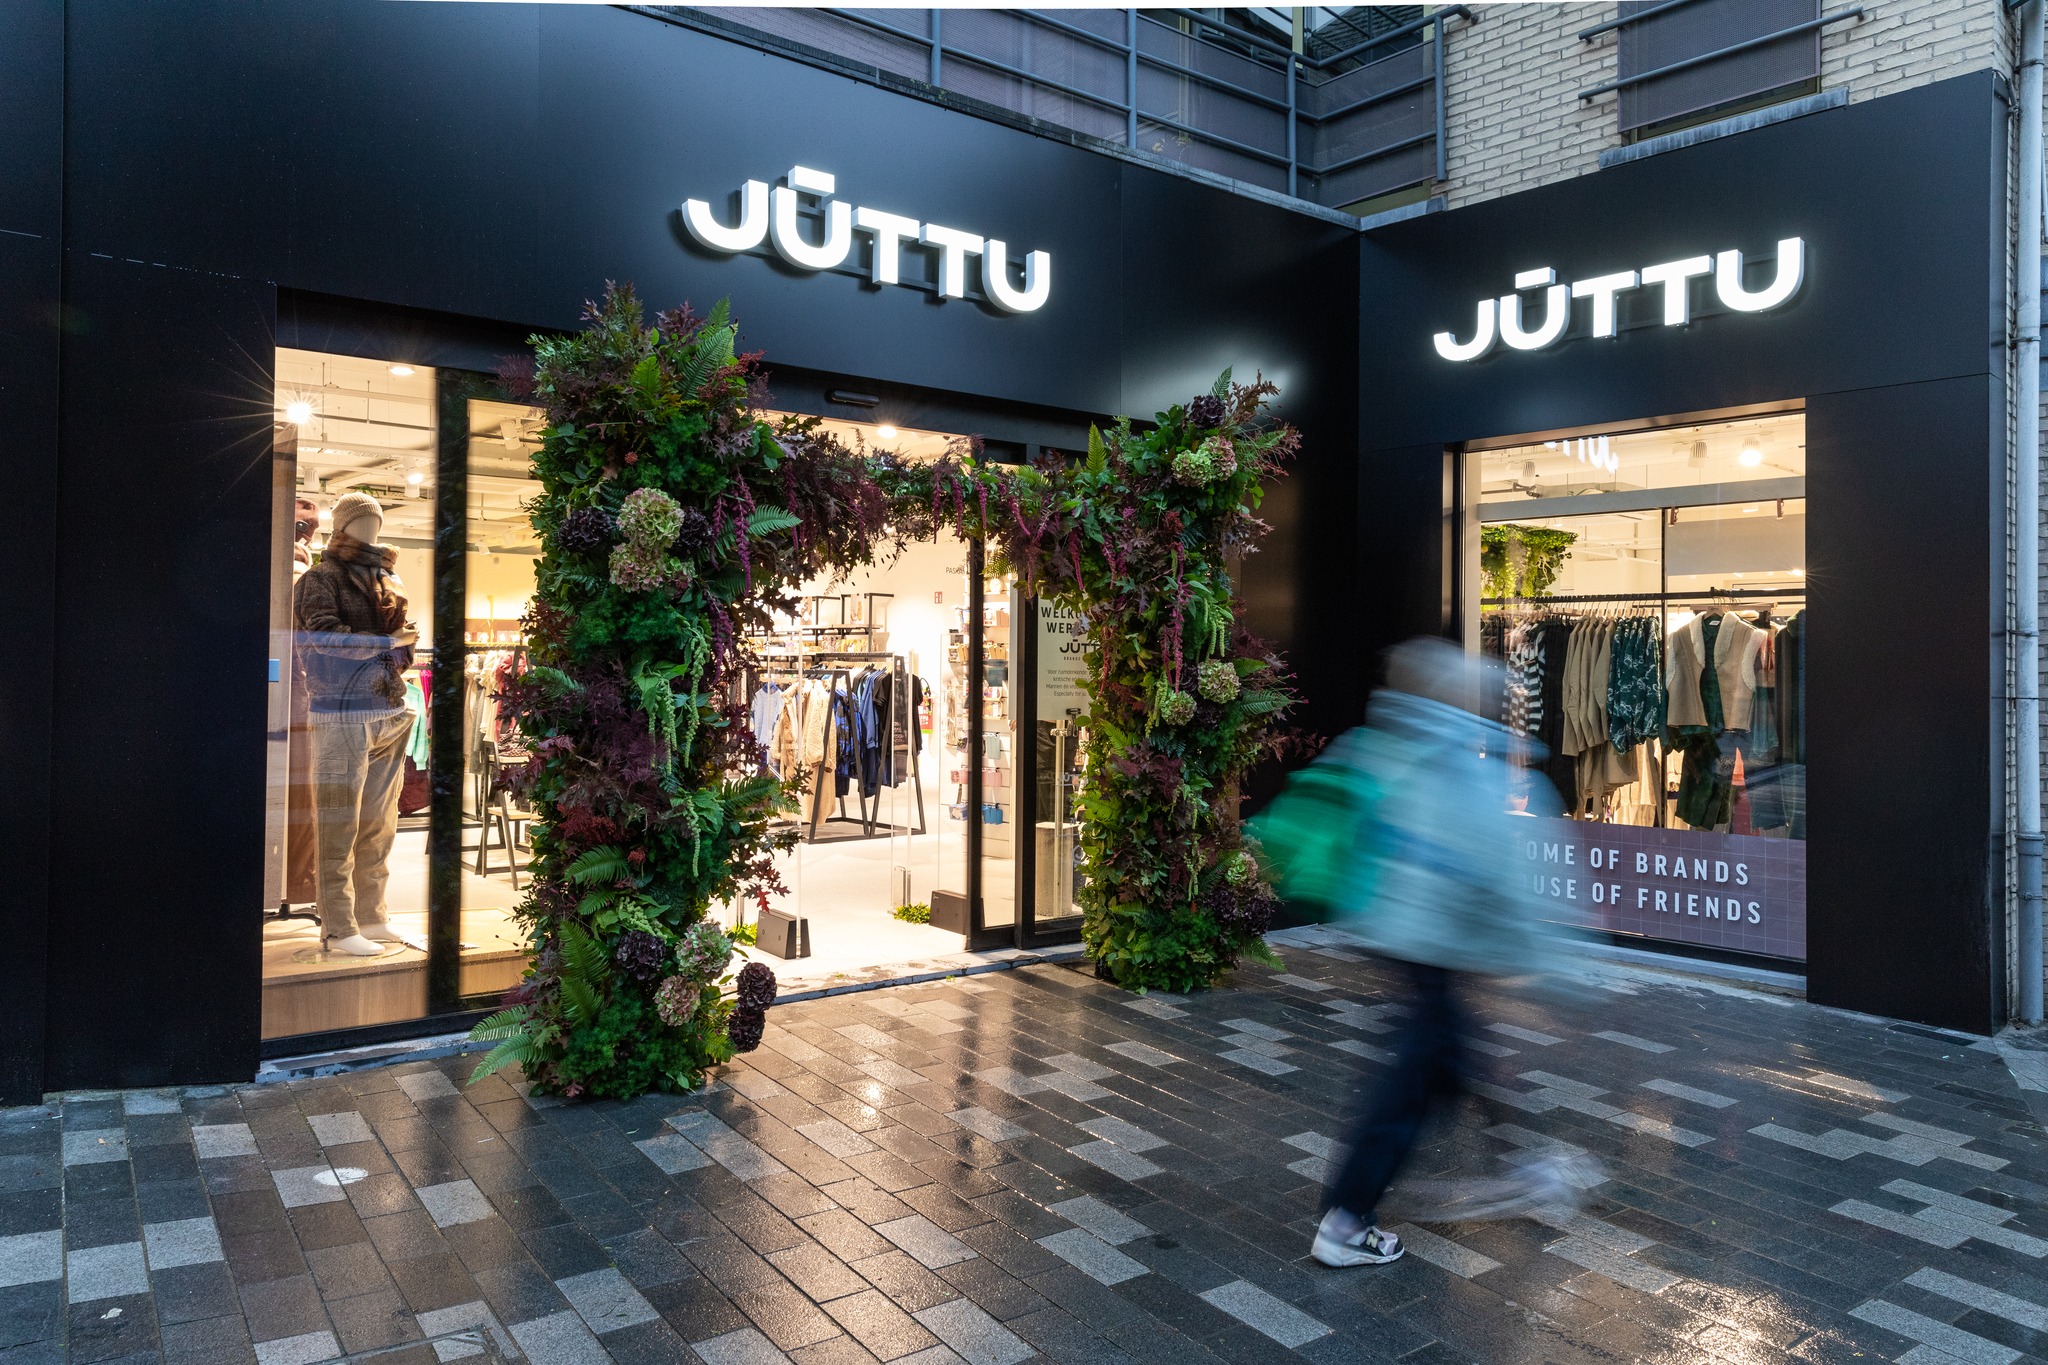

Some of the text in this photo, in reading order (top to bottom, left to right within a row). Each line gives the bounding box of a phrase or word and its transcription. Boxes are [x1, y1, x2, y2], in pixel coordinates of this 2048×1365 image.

[1526, 840, 1749, 886] OME OF BRANDS
[1533, 874, 1761, 924] USE OF FRIENDS
